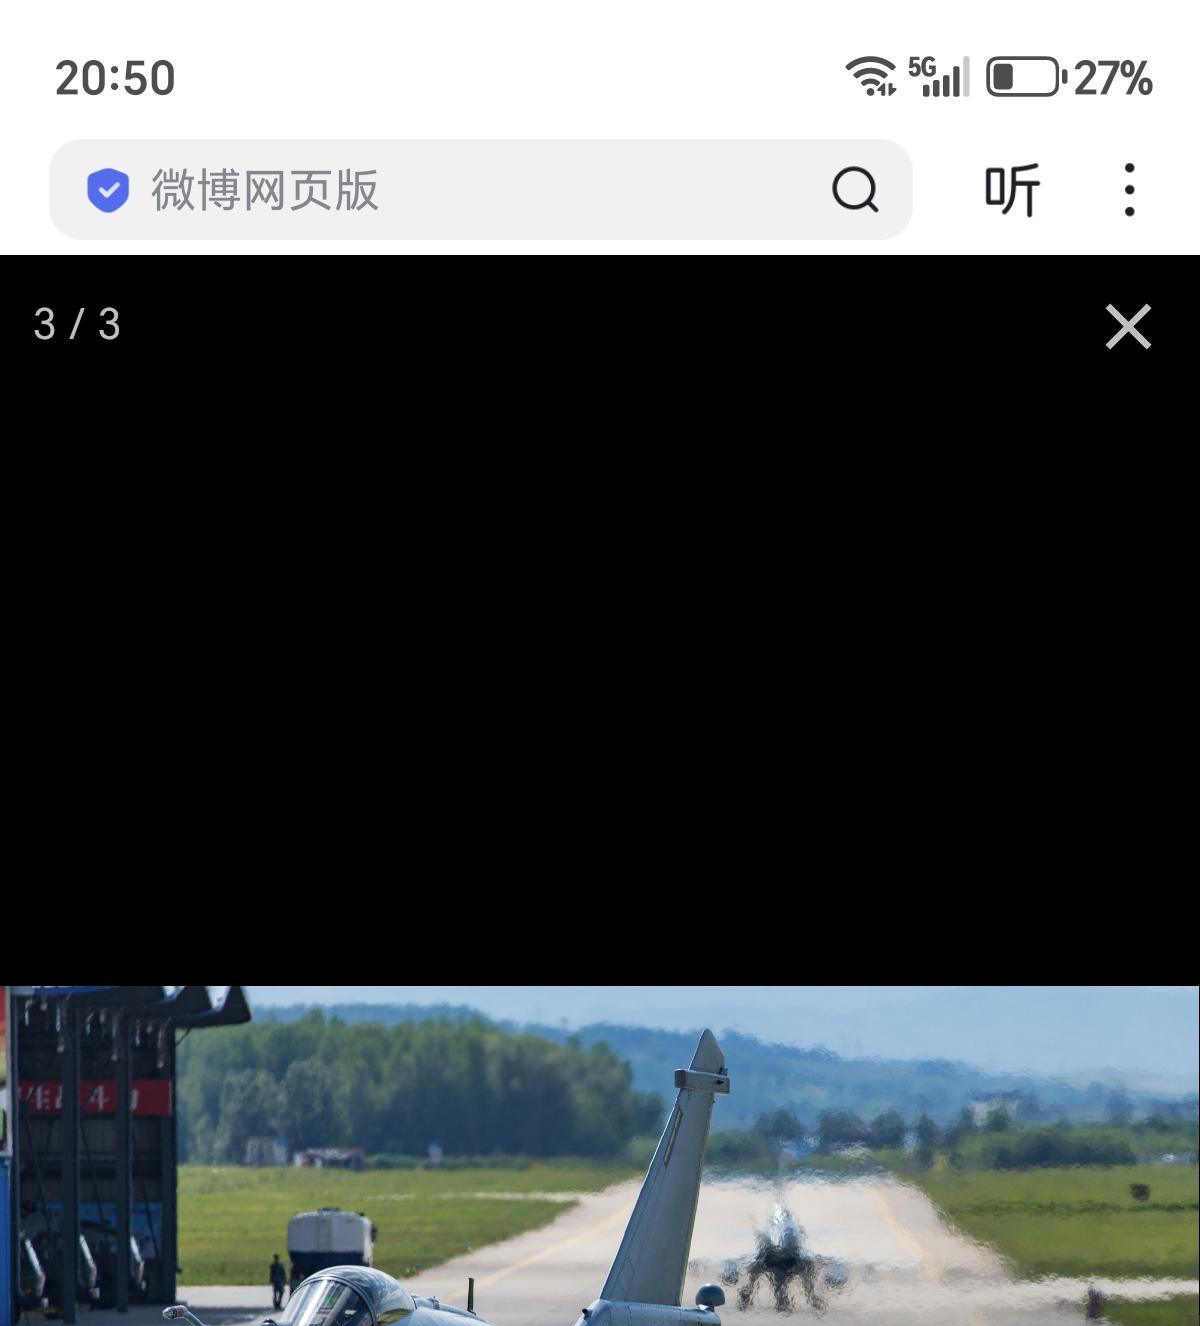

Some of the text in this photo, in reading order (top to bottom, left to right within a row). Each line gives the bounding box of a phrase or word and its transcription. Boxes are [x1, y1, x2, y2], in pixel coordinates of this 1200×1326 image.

[55, 59, 175, 96] 20:50
[907, 55, 937, 78] 5G
[1074, 59, 1154, 96] 27%
[151, 167, 379, 212] 微博网页版
[984, 162, 1042, 219] 听
